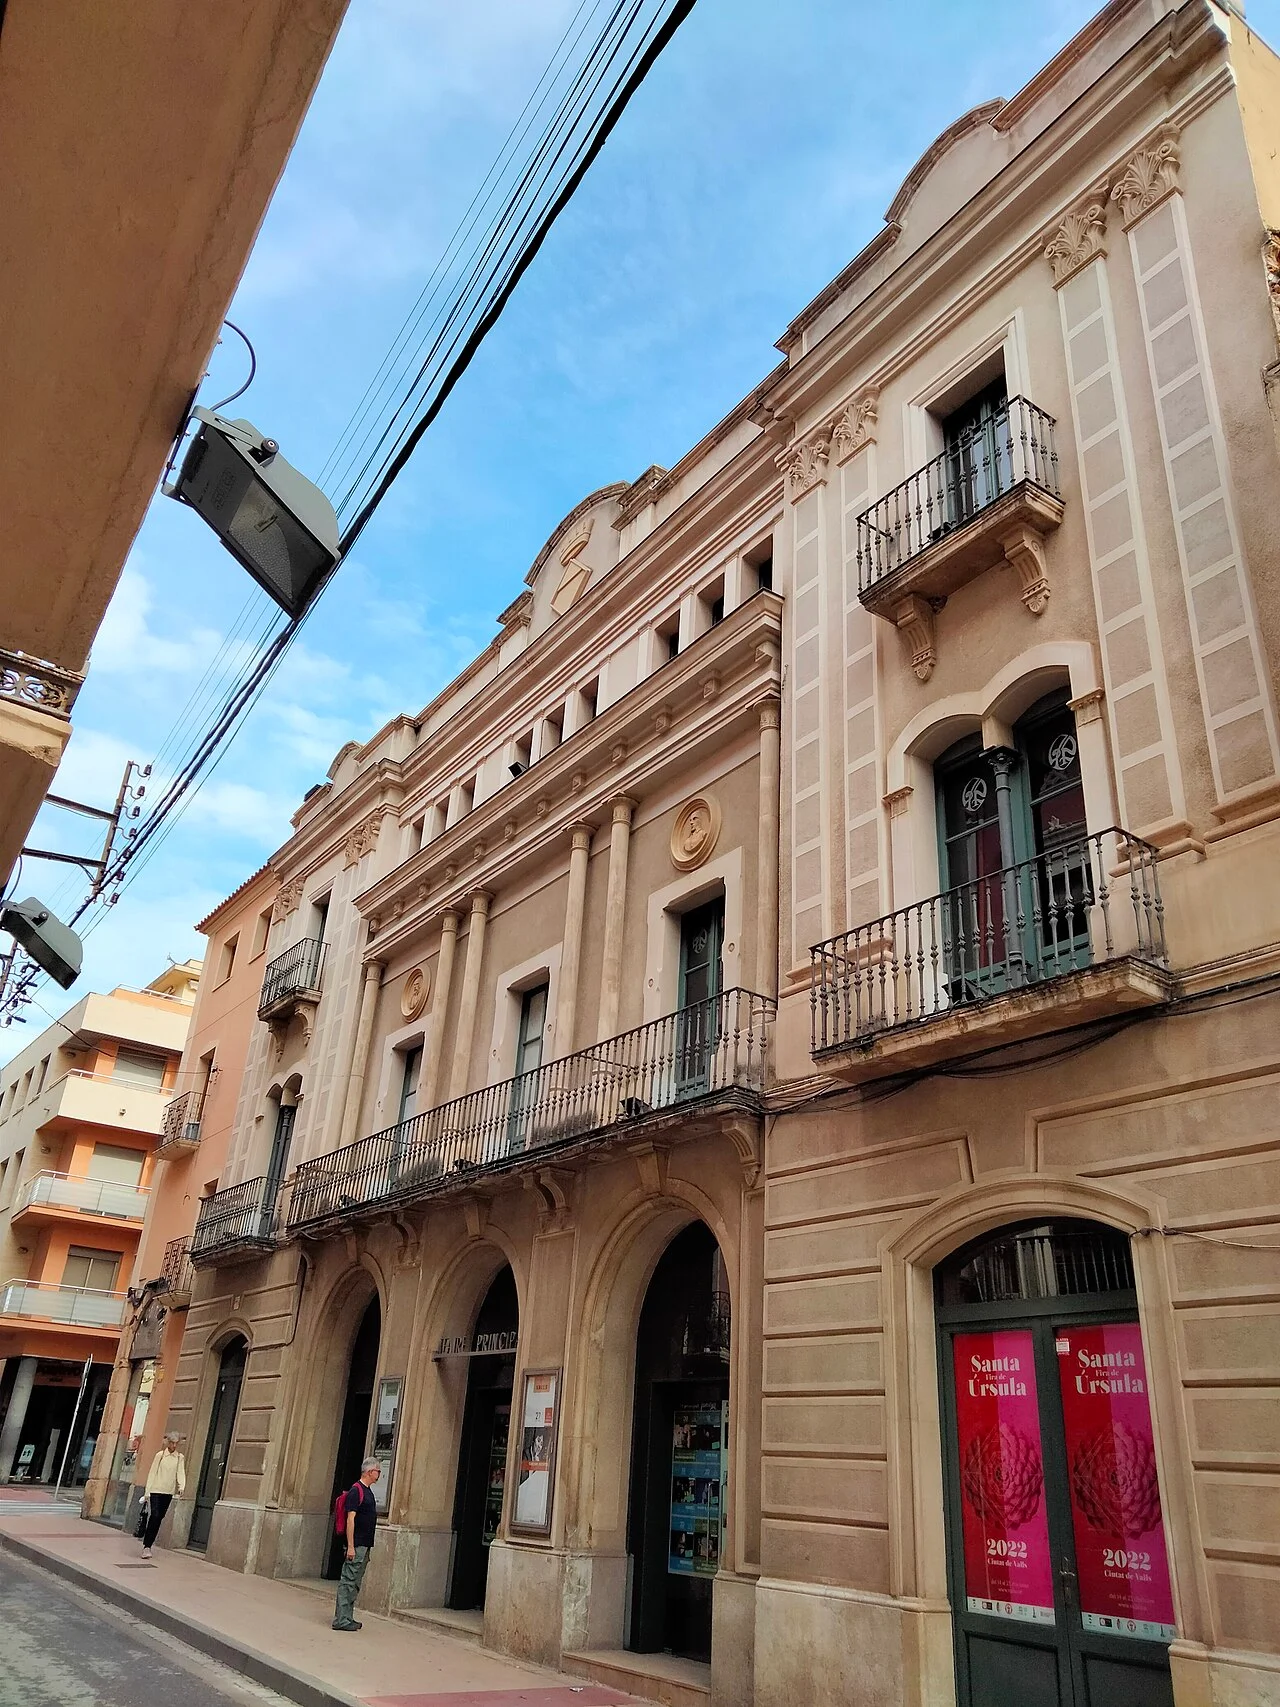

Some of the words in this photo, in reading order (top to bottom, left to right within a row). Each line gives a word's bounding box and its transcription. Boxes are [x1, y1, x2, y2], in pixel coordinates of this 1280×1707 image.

[971, 1354, 1020, 1373] Santa
[1077, 1349, 1136, 1368] Santa
[968, 1373, 1027, 1397] Úrsula
[1074, 1369, 1144, 1395] Úrsula
[986, 1538, 1028, 1558] 2022
[1005, 1559, 1012, 1567] de
[1102, 1548, 1152, 1571] 2022
[1125, 1572, 1133, 1580] de
